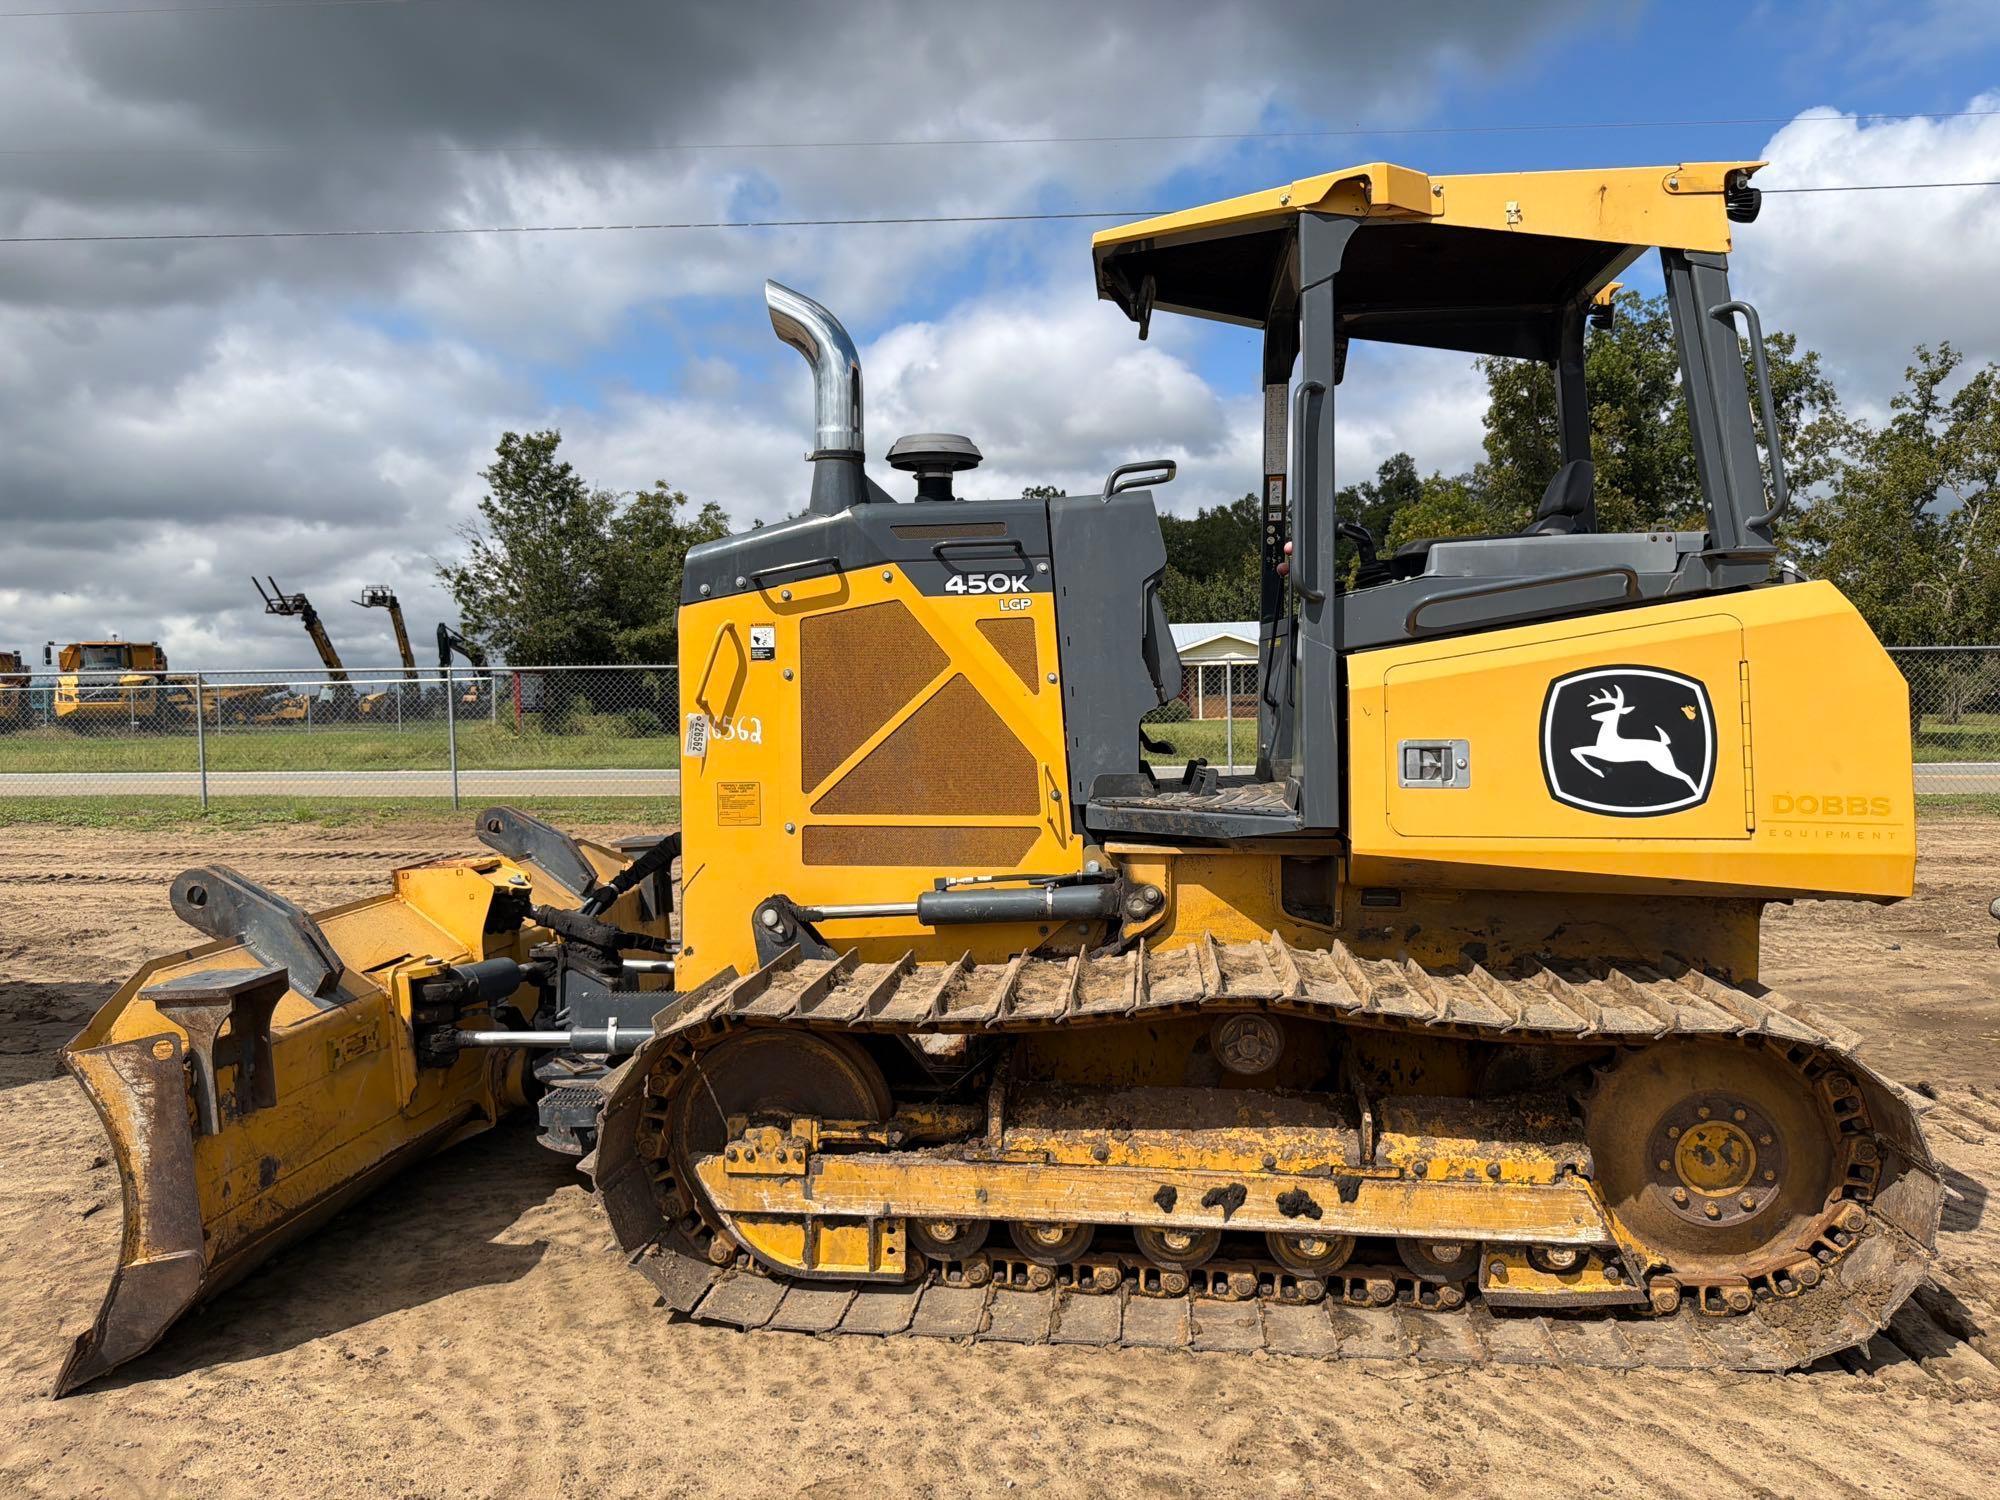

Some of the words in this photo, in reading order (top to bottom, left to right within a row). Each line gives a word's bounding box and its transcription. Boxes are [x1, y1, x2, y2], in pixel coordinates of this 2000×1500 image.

[945, 573, 1031, 595] 450K
[999, 598, 1033, 611] LGP
[692, 722, 705, 752] 226562
[706, 714, 763, 745] 6562
[1771, 794, 1893, 817] DOBBS
[1768, 828, 1897, 840] EQUIPMENT
